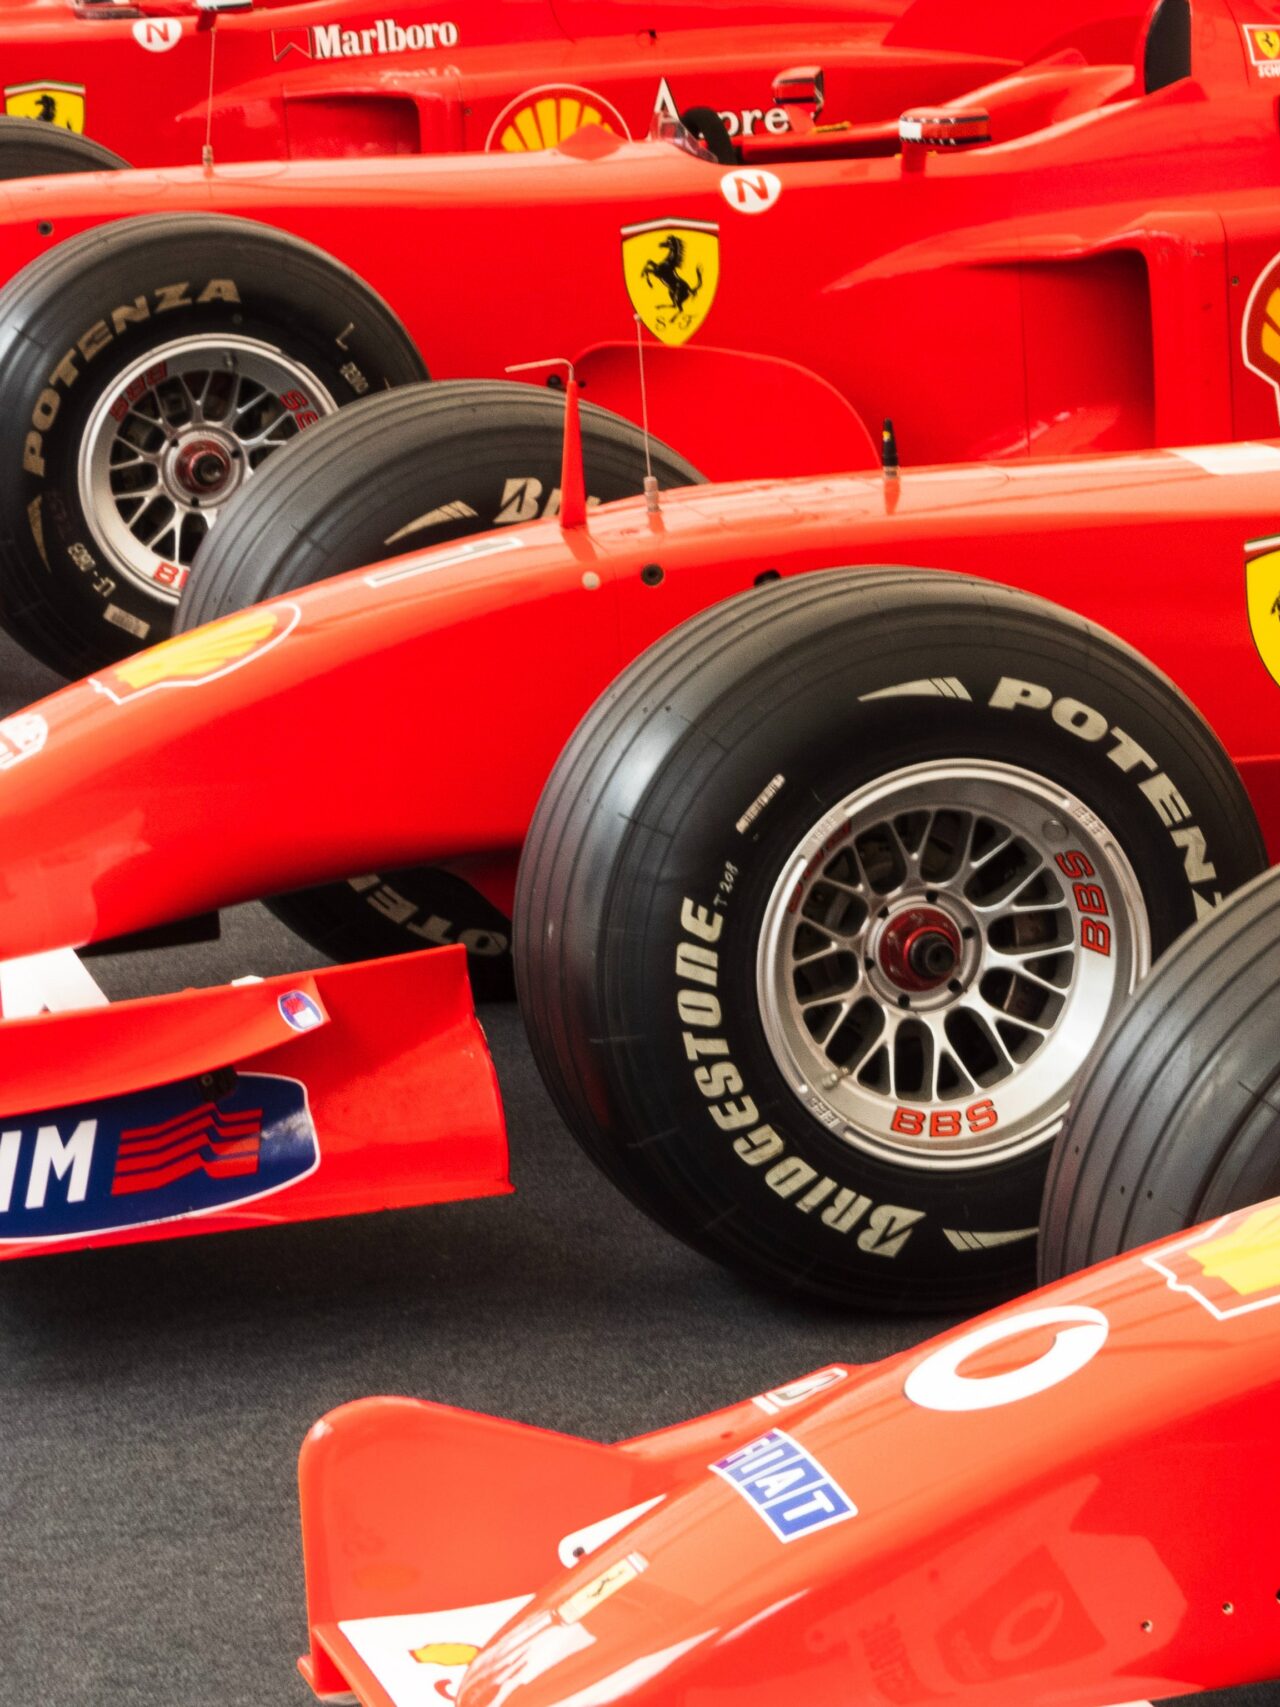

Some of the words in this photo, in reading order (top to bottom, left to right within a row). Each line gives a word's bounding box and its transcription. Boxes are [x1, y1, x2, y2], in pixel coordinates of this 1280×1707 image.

[145, 22, 170, 43] N
[313, 19, 458, 60] Marlboro
[735, 175, 768, 203] N
[23, 278, 241, 478] POTENZA
[1055, 850, 1112, 957] BBS
[675, 896, 927, 1259] BRIDGESTONE
[890, 1098, 999, 1138] BBS
[725, 1436, 836, 1522] FIAT
